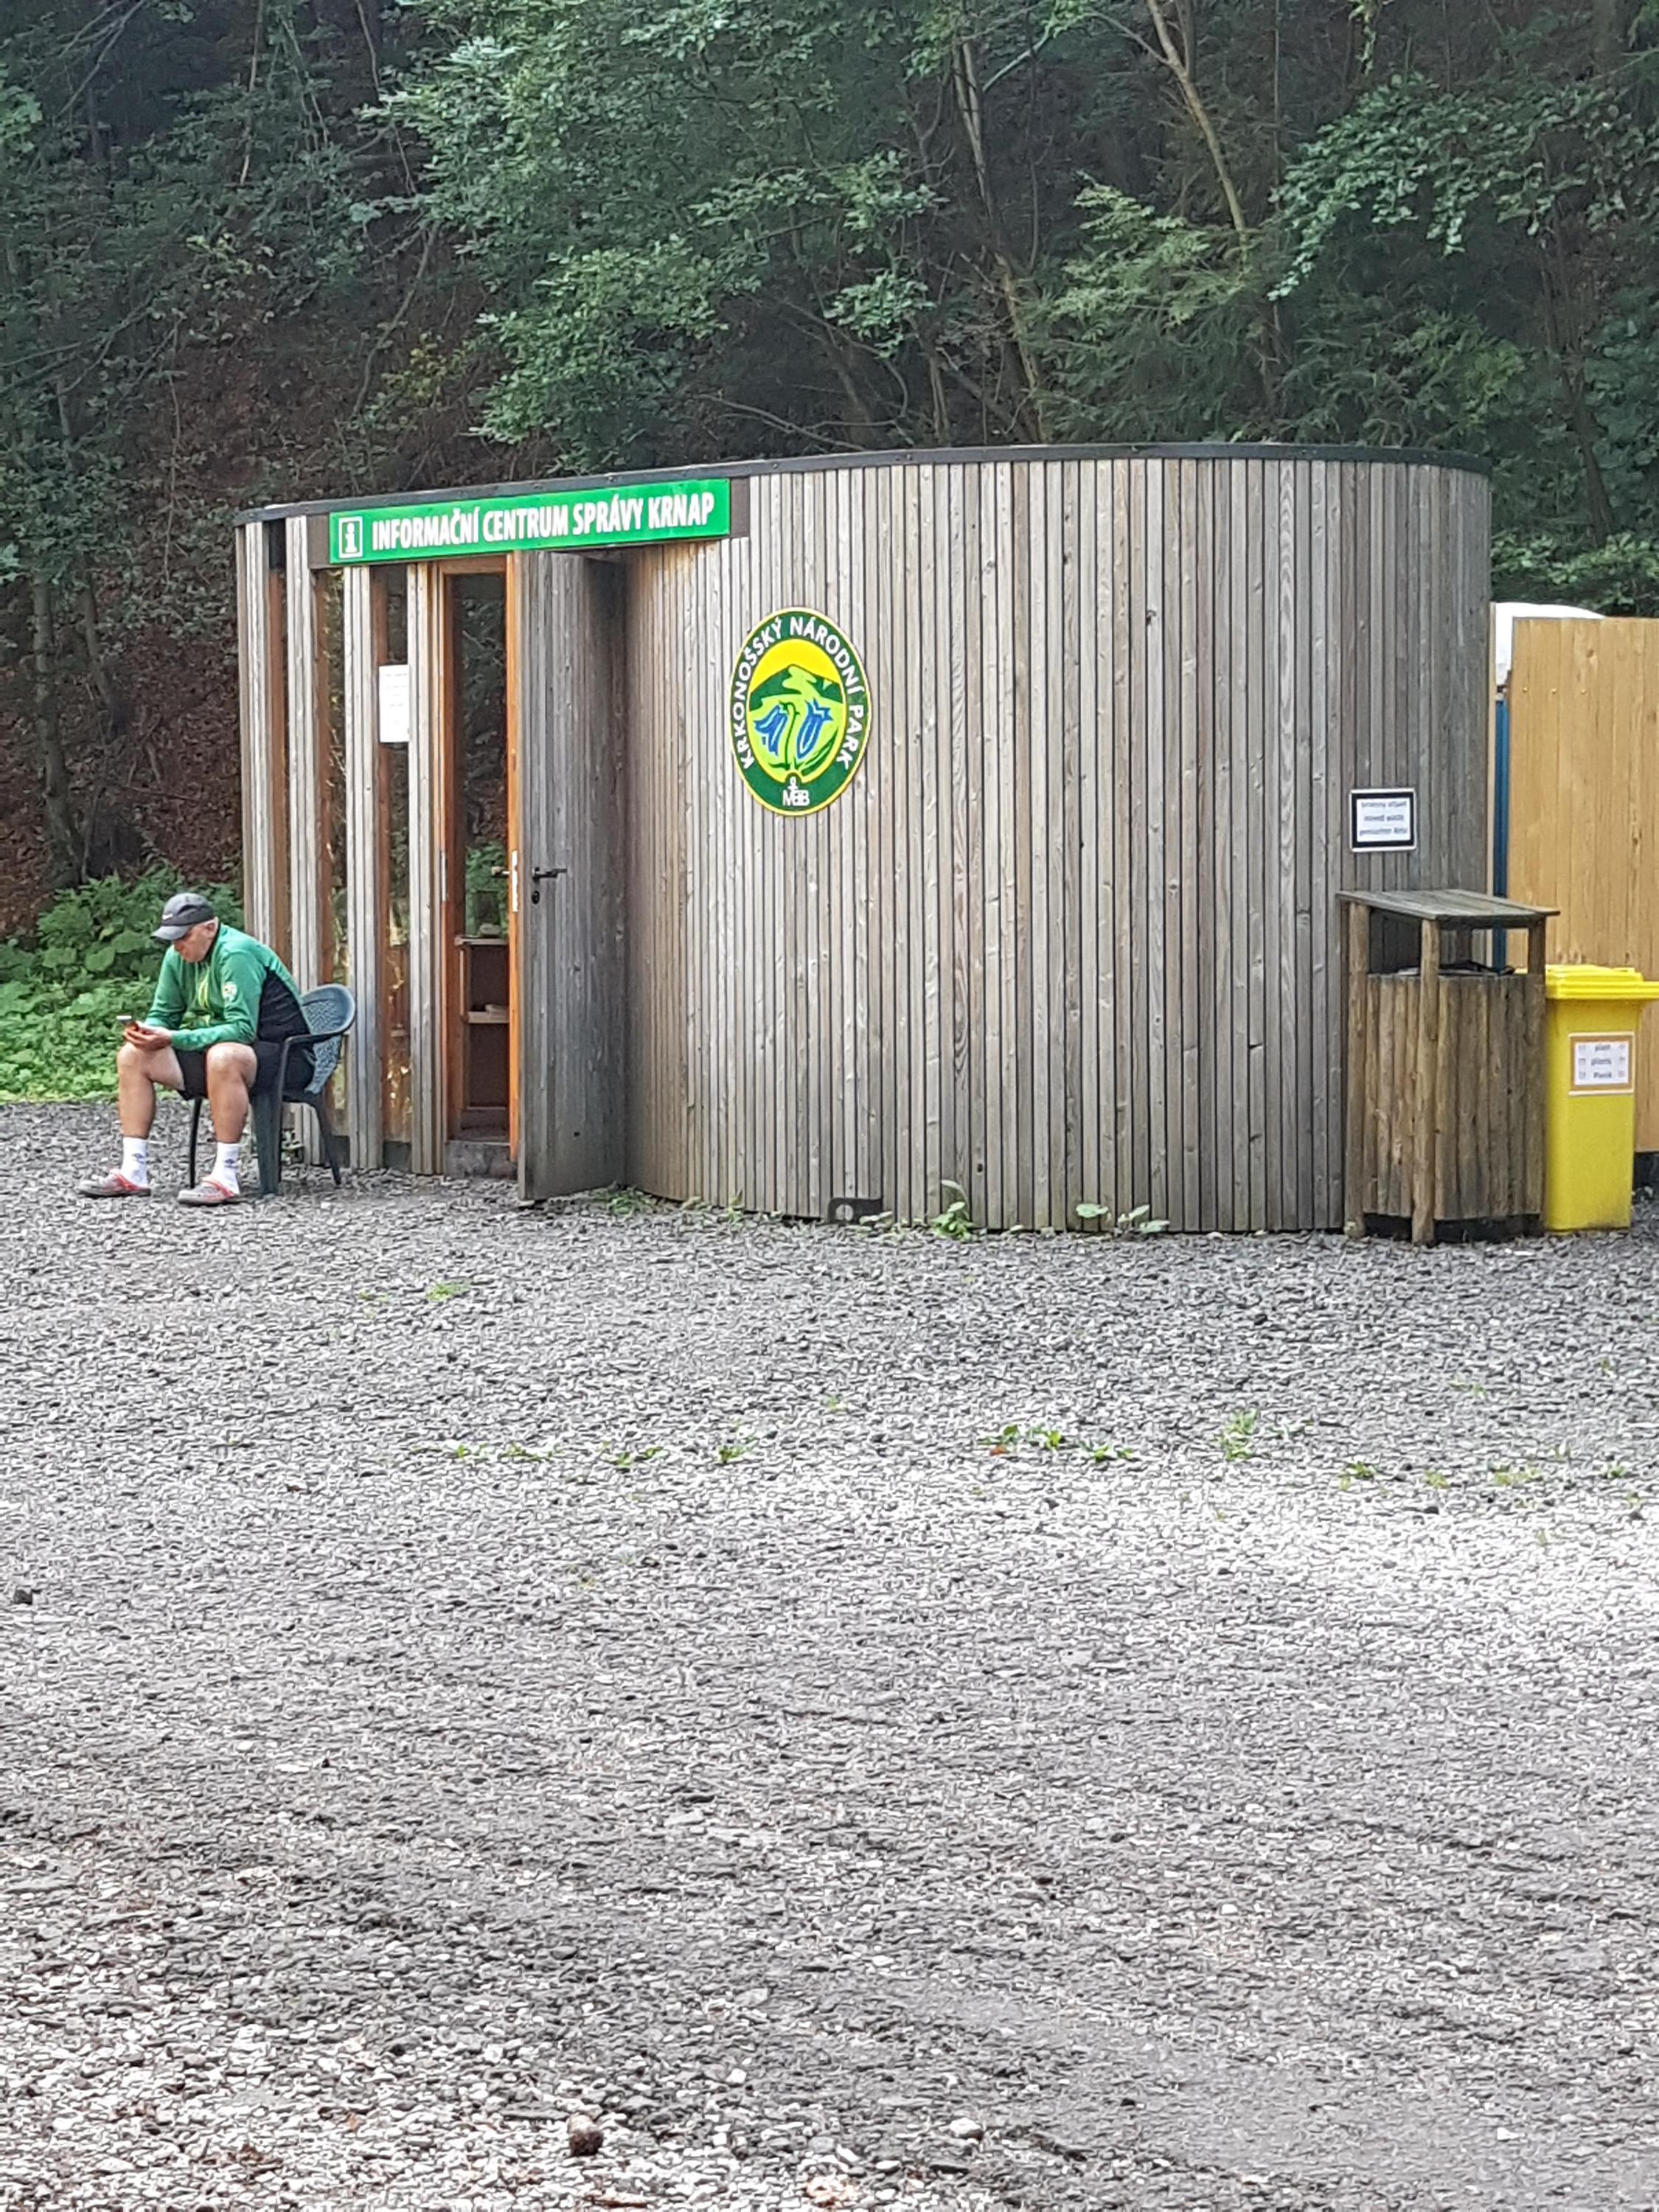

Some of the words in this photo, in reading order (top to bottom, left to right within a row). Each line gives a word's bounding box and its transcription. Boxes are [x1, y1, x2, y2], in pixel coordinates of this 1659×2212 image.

[372, 507, 480, 551] INFORMAČNÍ
[483, 503, 568, 543] CENTRUM
[573, 494, 644, 535] SPRÁVY
[648, 493, 714, 529] KRNAP
[731, 616, 783, 769] KRKONOŠSKÝ
[790, 616, 866, 694] NÁRODNÍ
[836, 704, 864, 770] PARK
